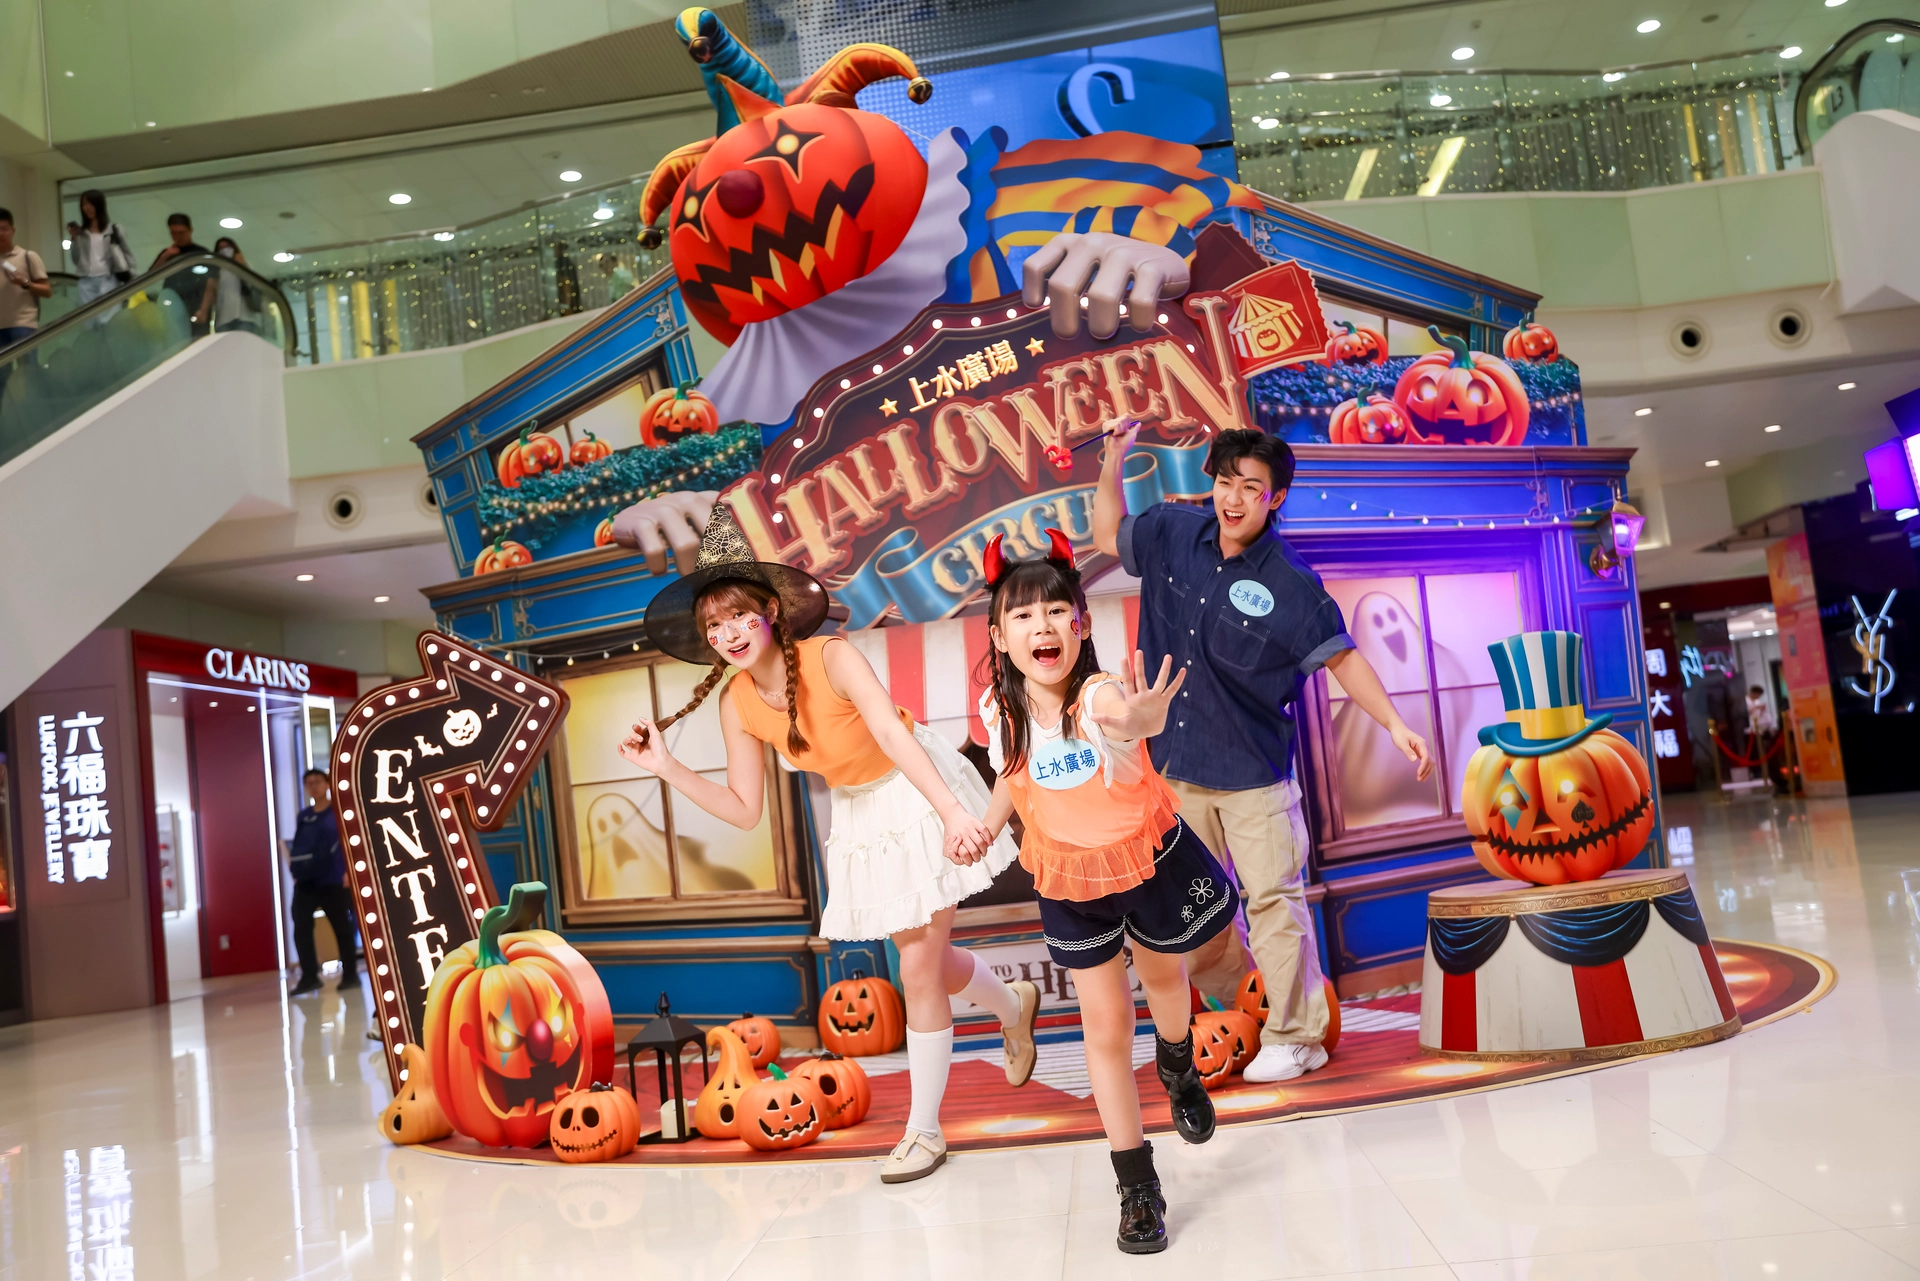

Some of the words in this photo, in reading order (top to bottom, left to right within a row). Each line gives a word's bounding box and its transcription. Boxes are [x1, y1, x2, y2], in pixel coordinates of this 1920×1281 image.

[1830, 85, 1844, 112] L3
[908, 339, 1019, 413] 上水廣場
[719, 295, 1250, 576] HALLOWEEN
[931, 489, 1096, 594] CIRCU
[1231, 585, 1272, 613] 上水廣場
[205, 648, 311, 692] CLARINS
[1645, 648, 1680, 758] 周大福
[60, 711, 112, 882] 六福珠寶
[1036, 748, 1096, 781] 上水廣場
[41, 791, 65, 884] JEWELLERY
[370, 746, 449, 1005] ENTE
